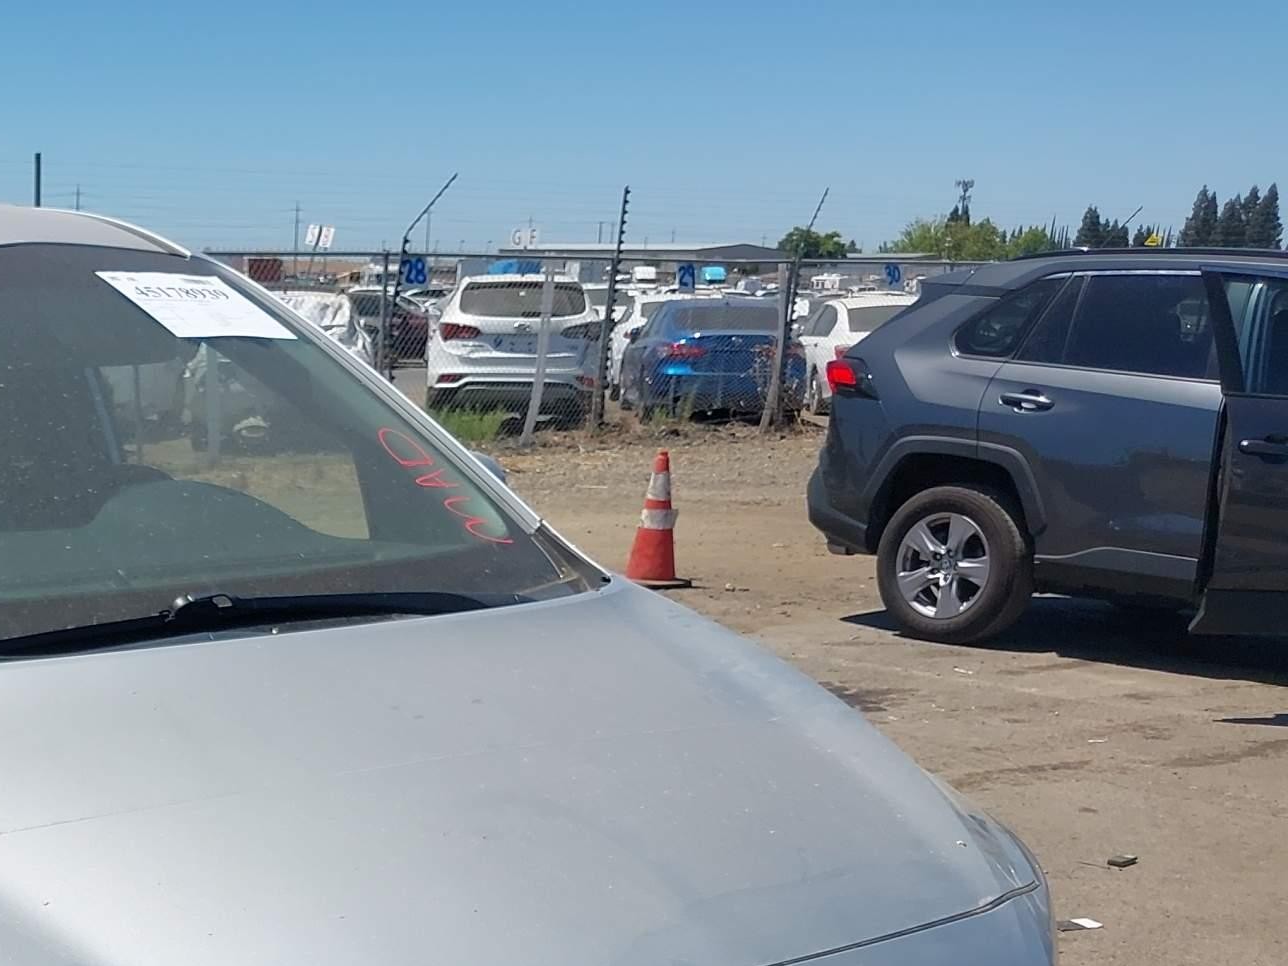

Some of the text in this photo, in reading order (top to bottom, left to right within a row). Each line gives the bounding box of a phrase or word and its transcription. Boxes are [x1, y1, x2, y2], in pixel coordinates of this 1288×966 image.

[402, 258, 427, 284] 28
[678, 264, 695, 288] 29
[884, 264, 901, 285] 30
[133, 286, 230, 300] 45178939
